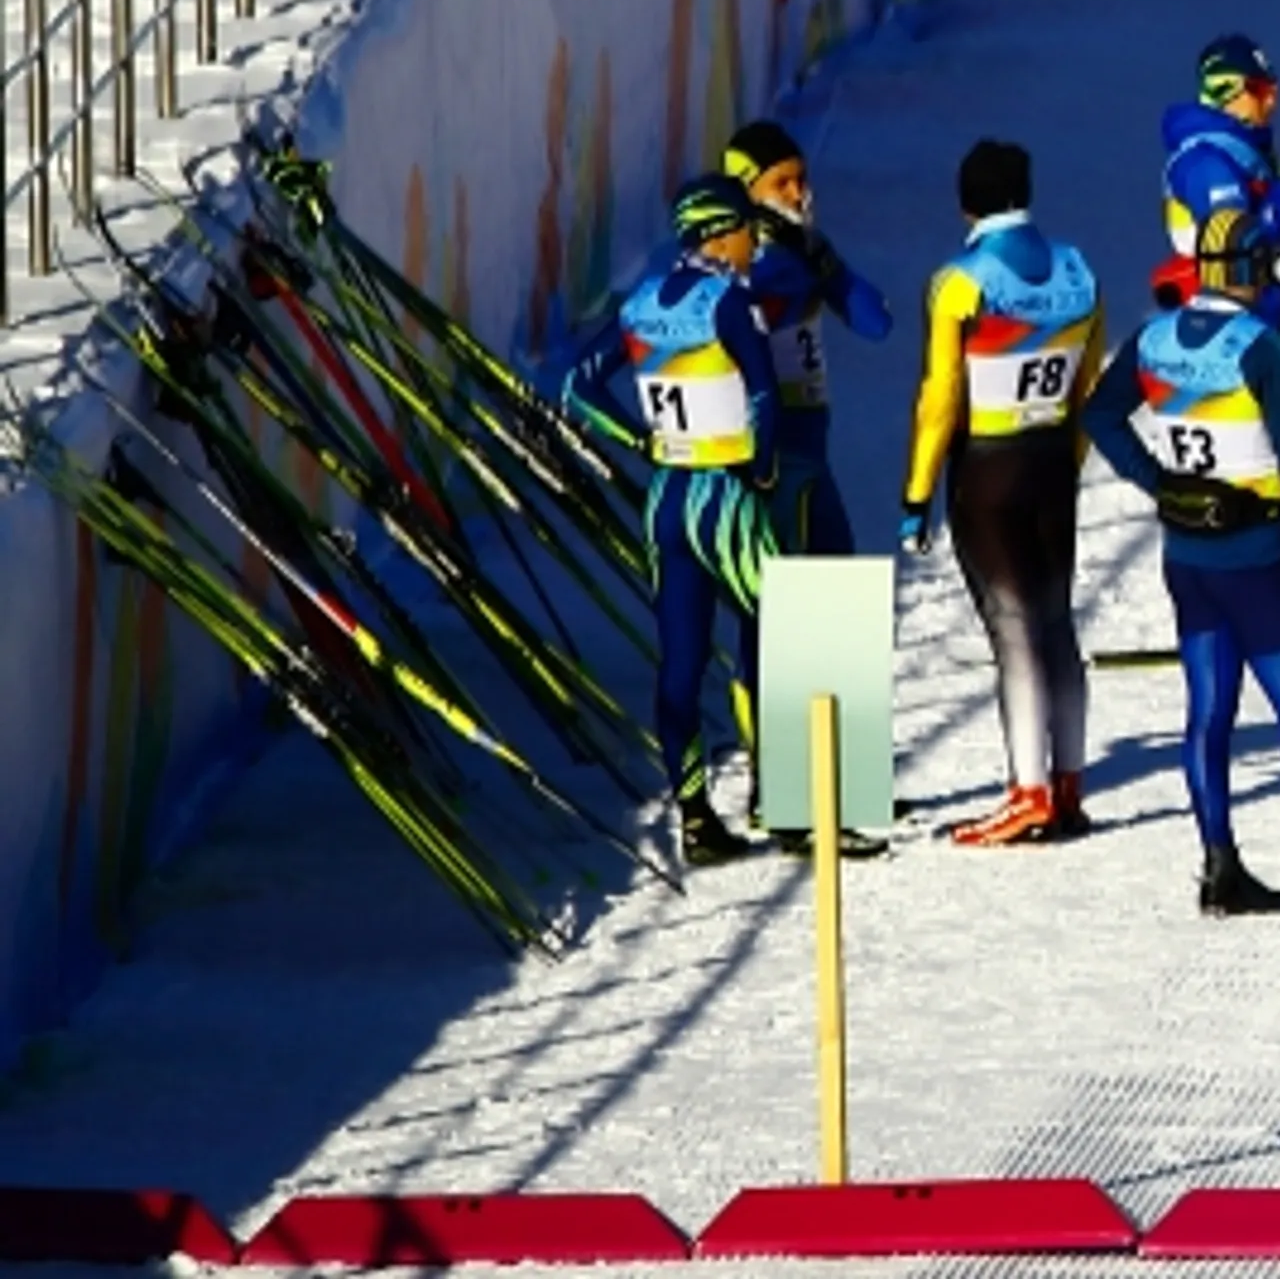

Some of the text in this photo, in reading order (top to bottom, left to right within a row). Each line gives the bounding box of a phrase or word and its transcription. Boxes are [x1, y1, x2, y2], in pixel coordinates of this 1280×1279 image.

[1017, 356, 1067, 402] F8
[648, 383, 688, 431] F1
[1169, 426, 1216, 471] F3
